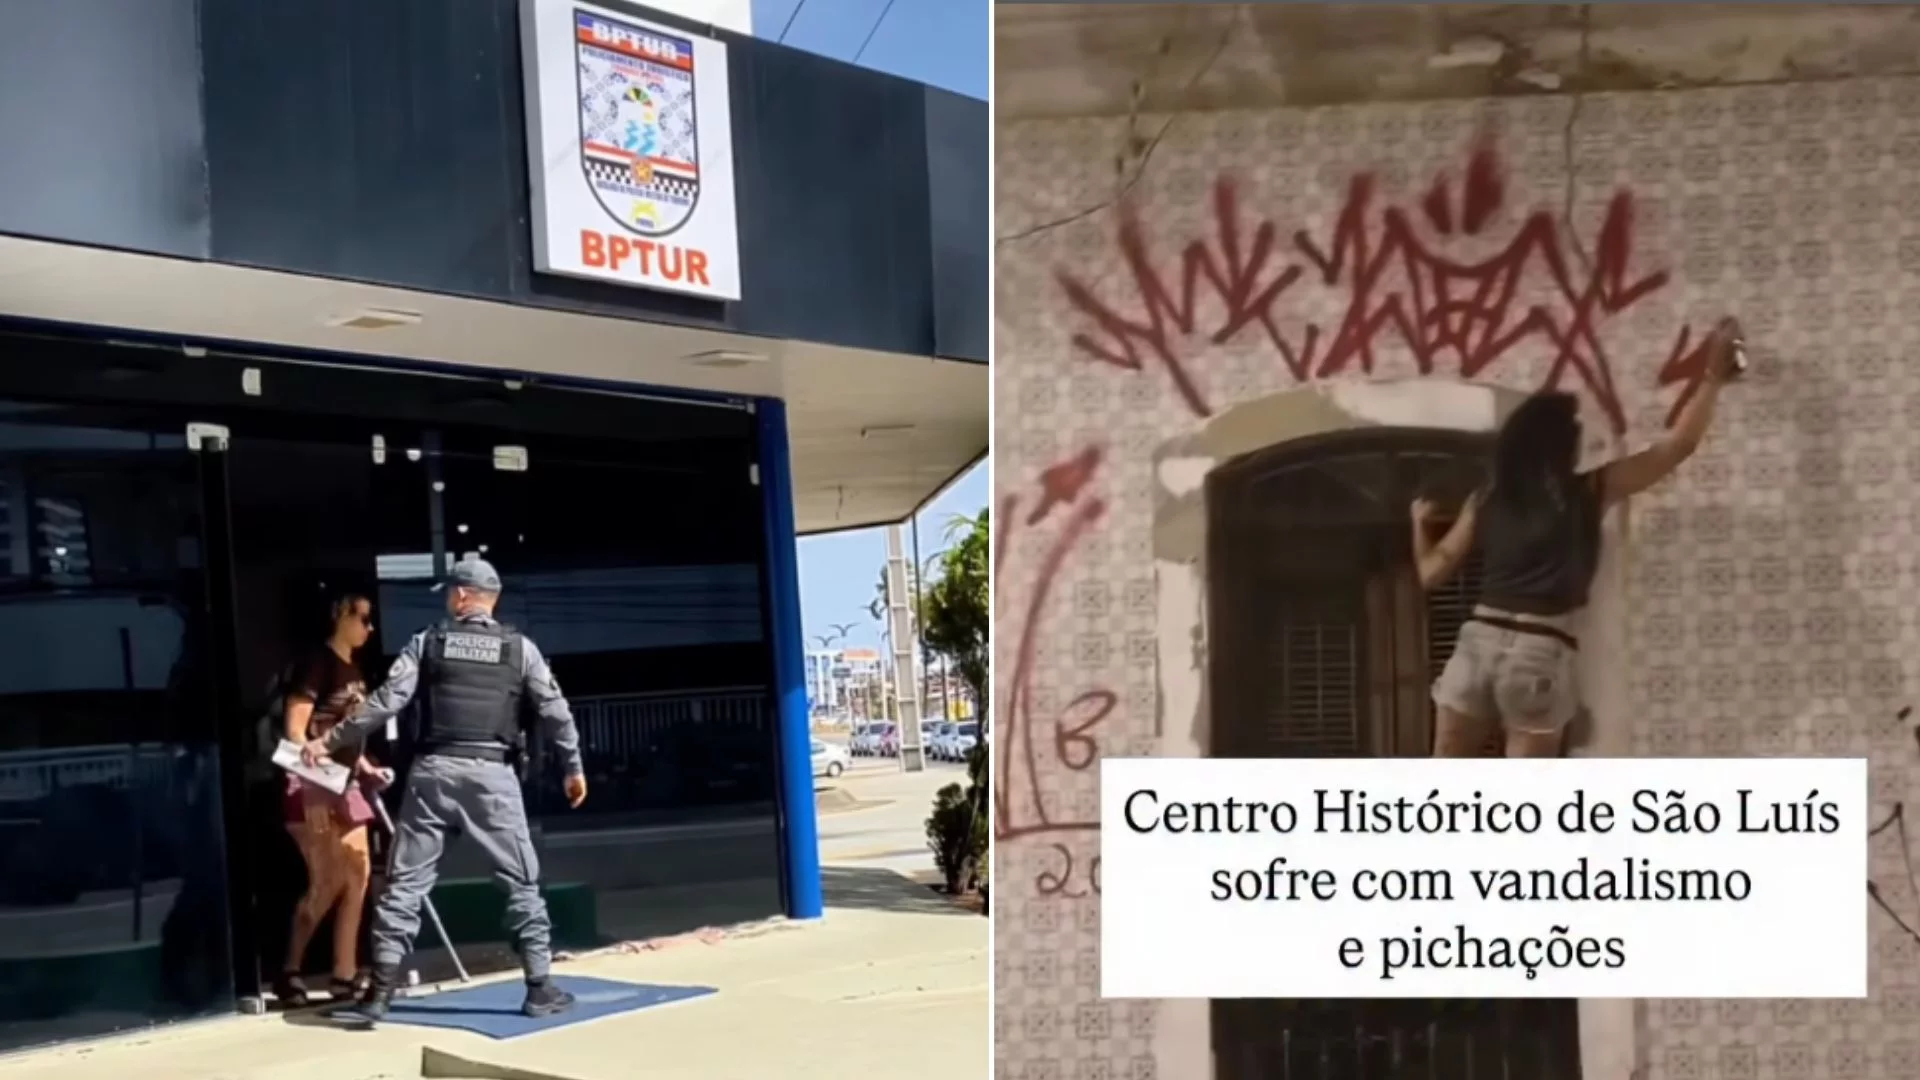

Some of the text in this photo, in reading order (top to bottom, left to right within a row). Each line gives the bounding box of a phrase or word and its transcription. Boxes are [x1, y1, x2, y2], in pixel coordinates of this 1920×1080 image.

[592, 20, 677, 60] BPTUR
[580, 229, 710, 286] BPTUR
[444, 648, 498, 663] MILITAR
